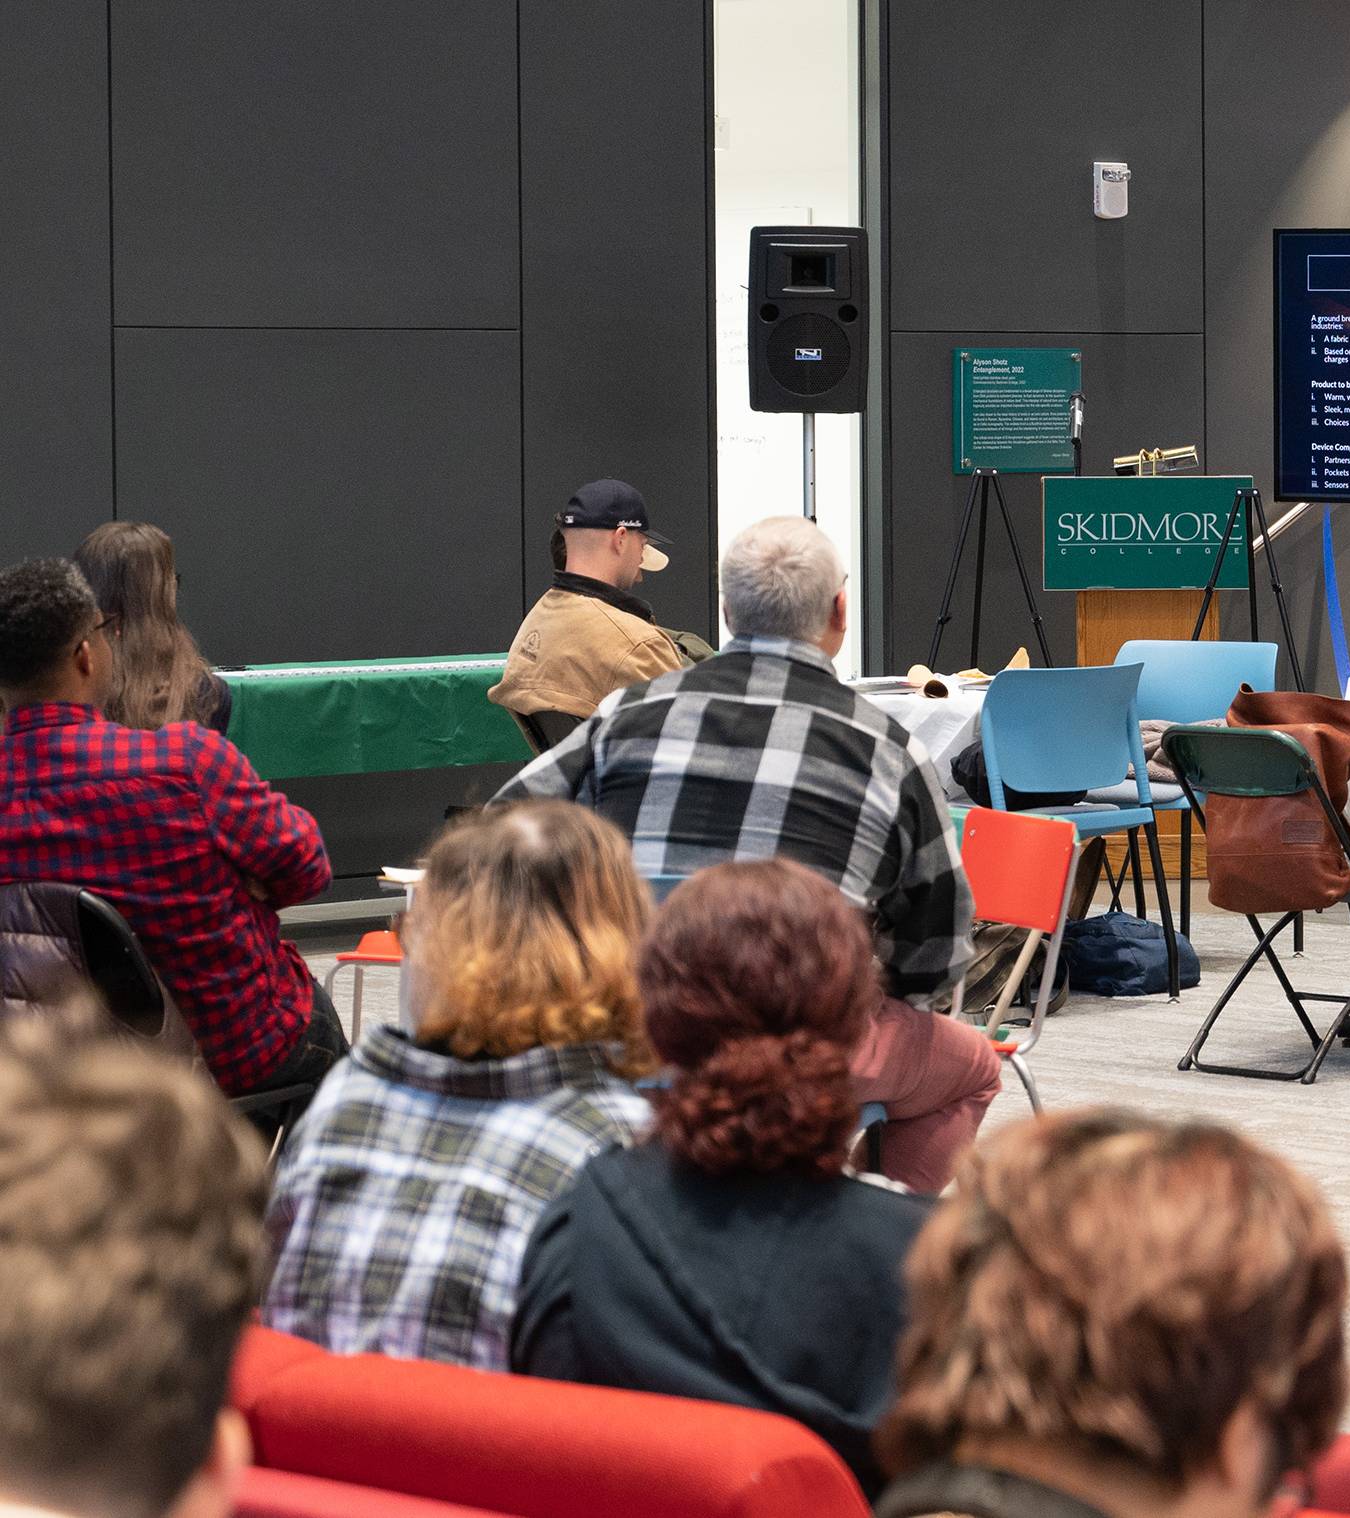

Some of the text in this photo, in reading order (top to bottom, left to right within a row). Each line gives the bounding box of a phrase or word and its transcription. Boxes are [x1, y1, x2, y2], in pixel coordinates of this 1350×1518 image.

[1318, 315, 1340, 323] ground
[1324, 335, 1330, 343] A
[1331, 335, 1349, 343] fabric
[1324, 356, 1349, 365] charges
[1324, 469, 1349, 477] Pockets
[1324, 481, 1349, 489] Sensors
[1057, 512, 1243, 542] SKIDMORE
[1060, 547, 1240, 555] COLLEGE
